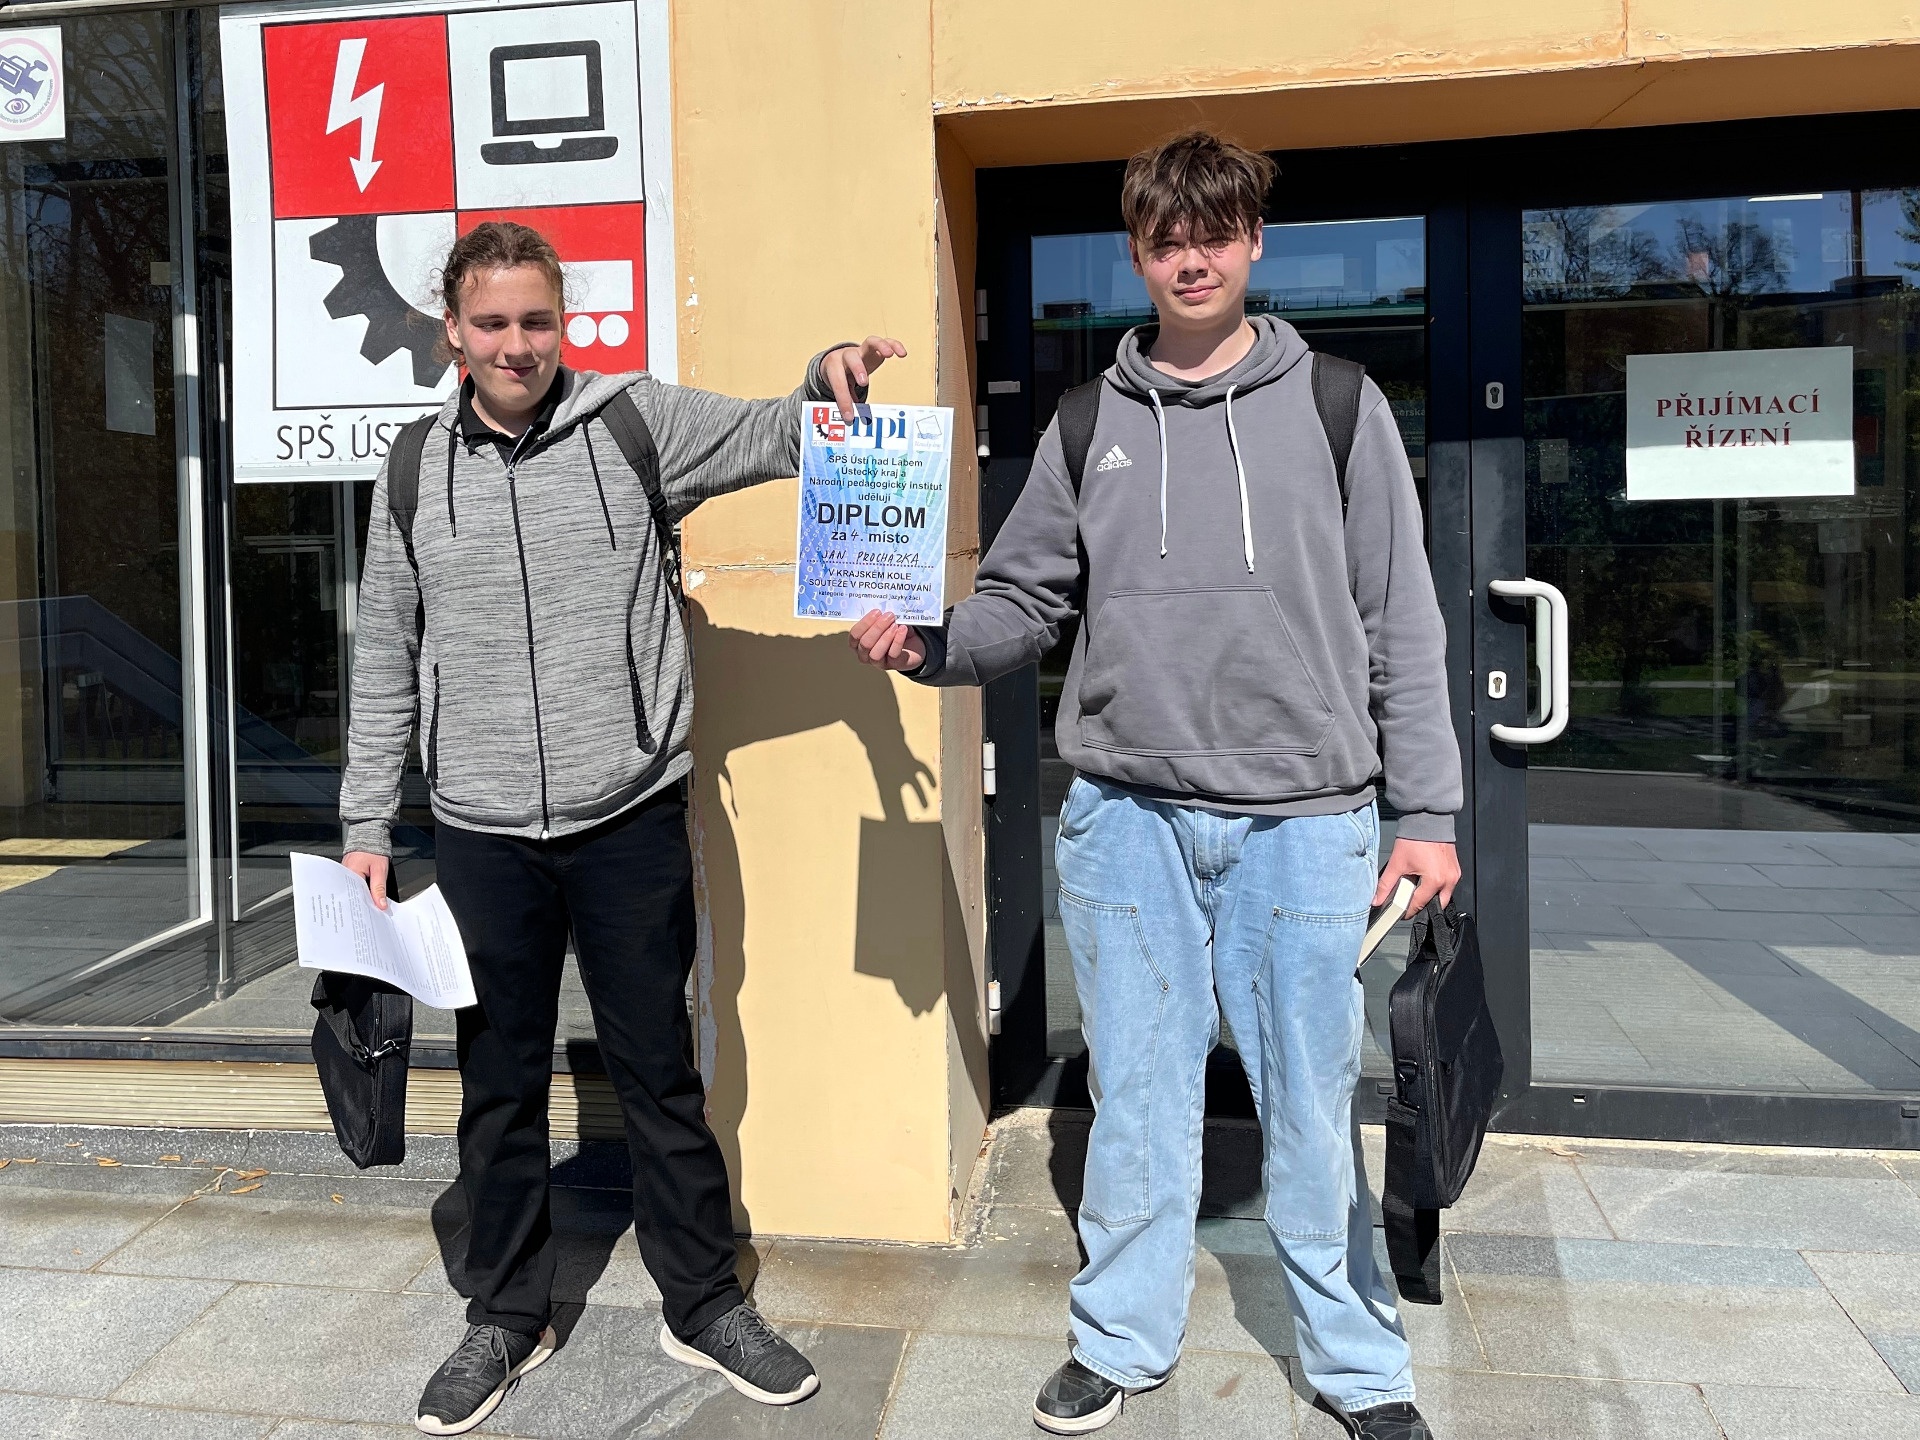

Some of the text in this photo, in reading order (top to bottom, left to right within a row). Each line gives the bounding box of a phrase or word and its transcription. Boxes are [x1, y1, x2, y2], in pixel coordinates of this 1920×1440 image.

[1656, 388, 1821, 418] PŘIJÍMACÍ
[276, 414, 335, 460] SPŠ
[1685, 421, 1793, 449] ŘÍZENÍ
[829, 455, 923, 467] SPŠ Ústí nad Labem
[1097, 459, 1133, 472] adidas
[841, 466, 907, 478] Ústecký kraj a
[809, 477, 943, 491] Národní pedagogický institut
[858, 492, 891, 503] udělují
[817, 503, 926, 529] DIPLOM
[831, 530, 847, 541] za
[868, 530, 910, 544] místo
[821, 549, 847, 560] JAN
[828, 569, 912, 581] V KRAJSKÉM KOLE
[808, 577, 932, 592] SOUTĚŽE V PROGRAMOVÁNÍ
